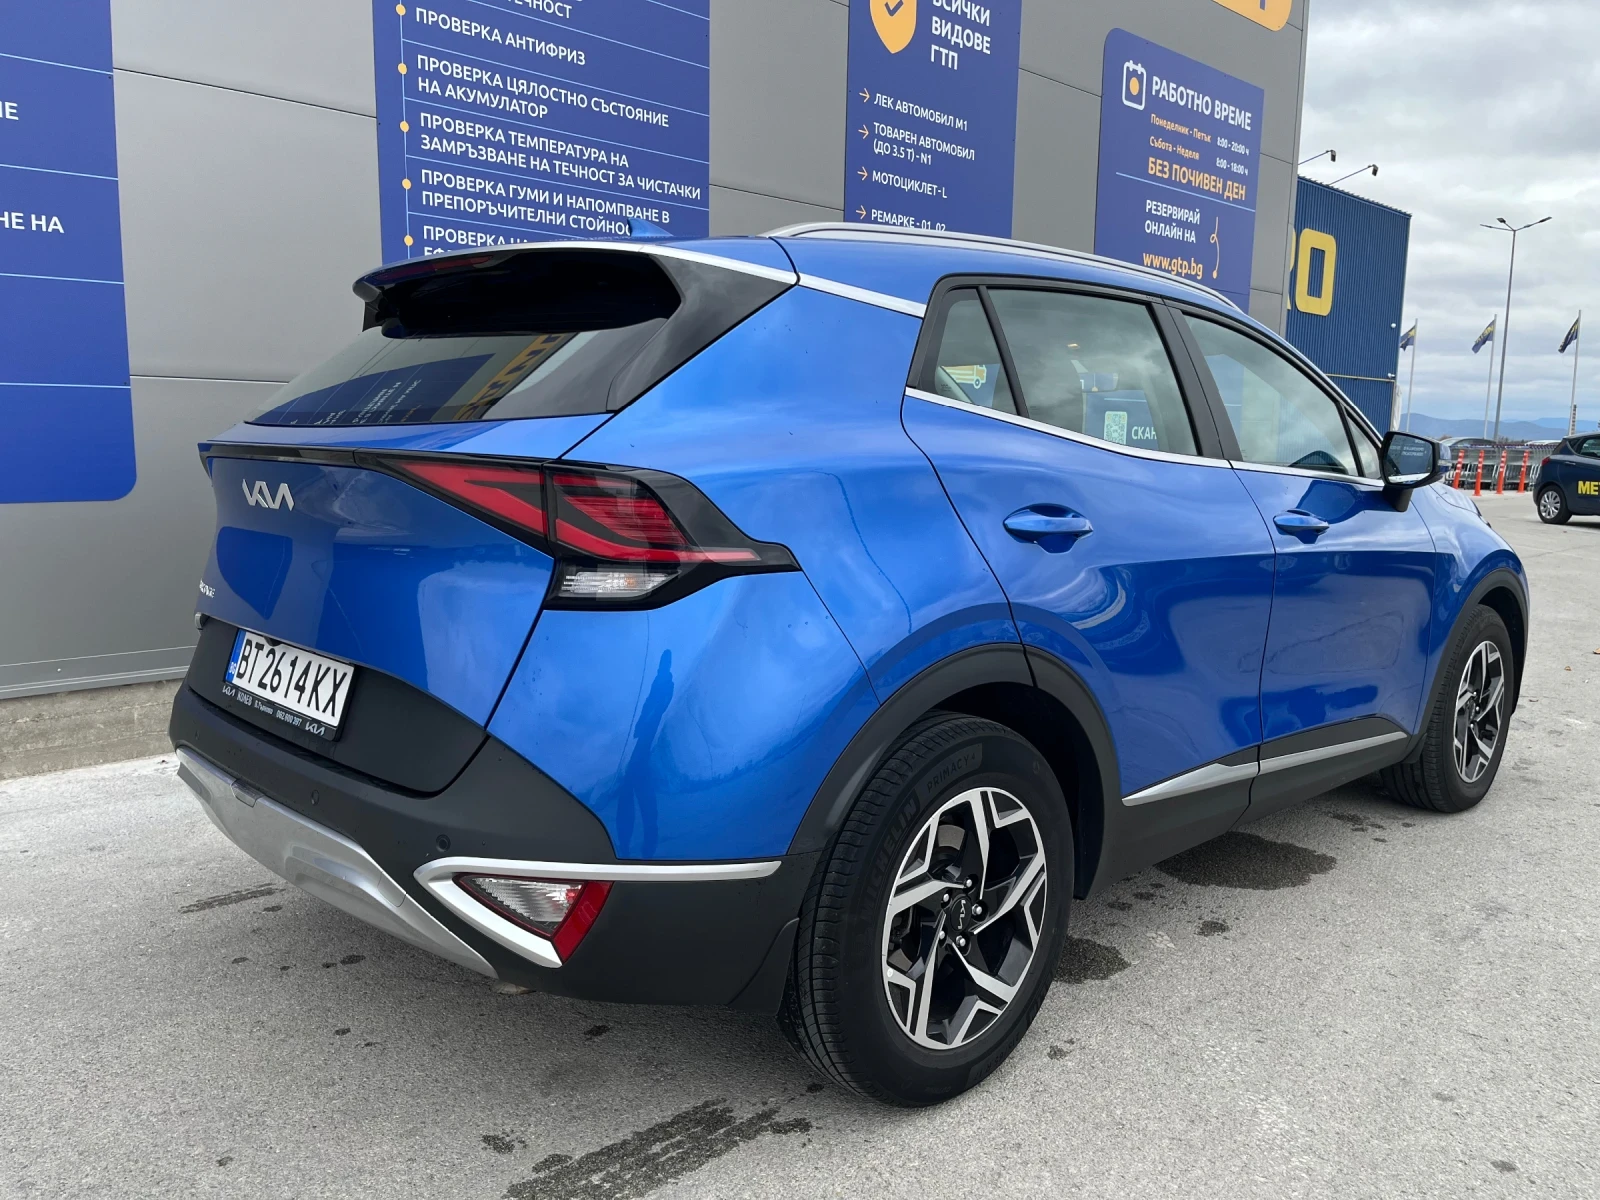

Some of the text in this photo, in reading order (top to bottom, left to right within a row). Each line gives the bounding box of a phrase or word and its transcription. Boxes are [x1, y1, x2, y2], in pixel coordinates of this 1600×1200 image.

[508, 0, 572, 18] ЧНОСТ
[416, 7, 585, 66] ПРОВЕРКА АНТИФРИЗ
[931, 16, 991, 55] ВИДОВЕ
[931, 44, 958, 70] ГТП
[417, 54, 669, 127] ПРОВЕРКА ЦЯЛОСТНО СЪСТОЯНИЕ
[419, 77, 548, 119] НА АКУМУЛАТОР
[1152, 76, 1252, 131] РАБОТНО ВРЕМЕ
[0, 100, 19, 121] Е
[874, 93, 894, 109] ЛЕК
[896, 100, 954, 127] АВТОМОБИЛ
[420, 113, 629, 168] ПРОВЕРКА ТЕМПЕРАТУРА НА
[873, 122, 974, 160] ТОВАРЕН АВТОМОБИЛ
[1151, 113, 1189, 135] Понеделник
[1193, 128, 1211, 142] Петък
[873, 138, 890, 156] (ДО
[892, 145, 905, 158] 3.5
[1150, 136, 1172, 152] Събота
[1176, 145, 1199, 160] Неделя
[421, 134, 701, 200] ЗАМРЪЗВАНЕ НА ТЕЧНОСТ ЗА ЧИСТАЧКИ
[1148, 157, 1246, 201] БЕЗ ПОЧИВЕН ДЕН
[421, 169, 670, 224] ПРОВЕРКА ГУМИ И НАПОМПВАНЕ В
[422, 191, 566, 227] ПРЕПОРЪЧИТЕЛНИ
[1146, 199, 1201, 225] РЕЗЕРВИРАЙ
[31, 213, 65, 234] НА
[871, 209, 915, 228] РЕМАРКЕ
[1144, 222, 1196, 243] ОНЛАЙН НА
[1143, 252, 1203, 280] www.gtp.bg
[242, 479, 294, 511] KIA
[1578, 480, 1600, 495] ME
[926, 754, 969, 793] PRIMACY
